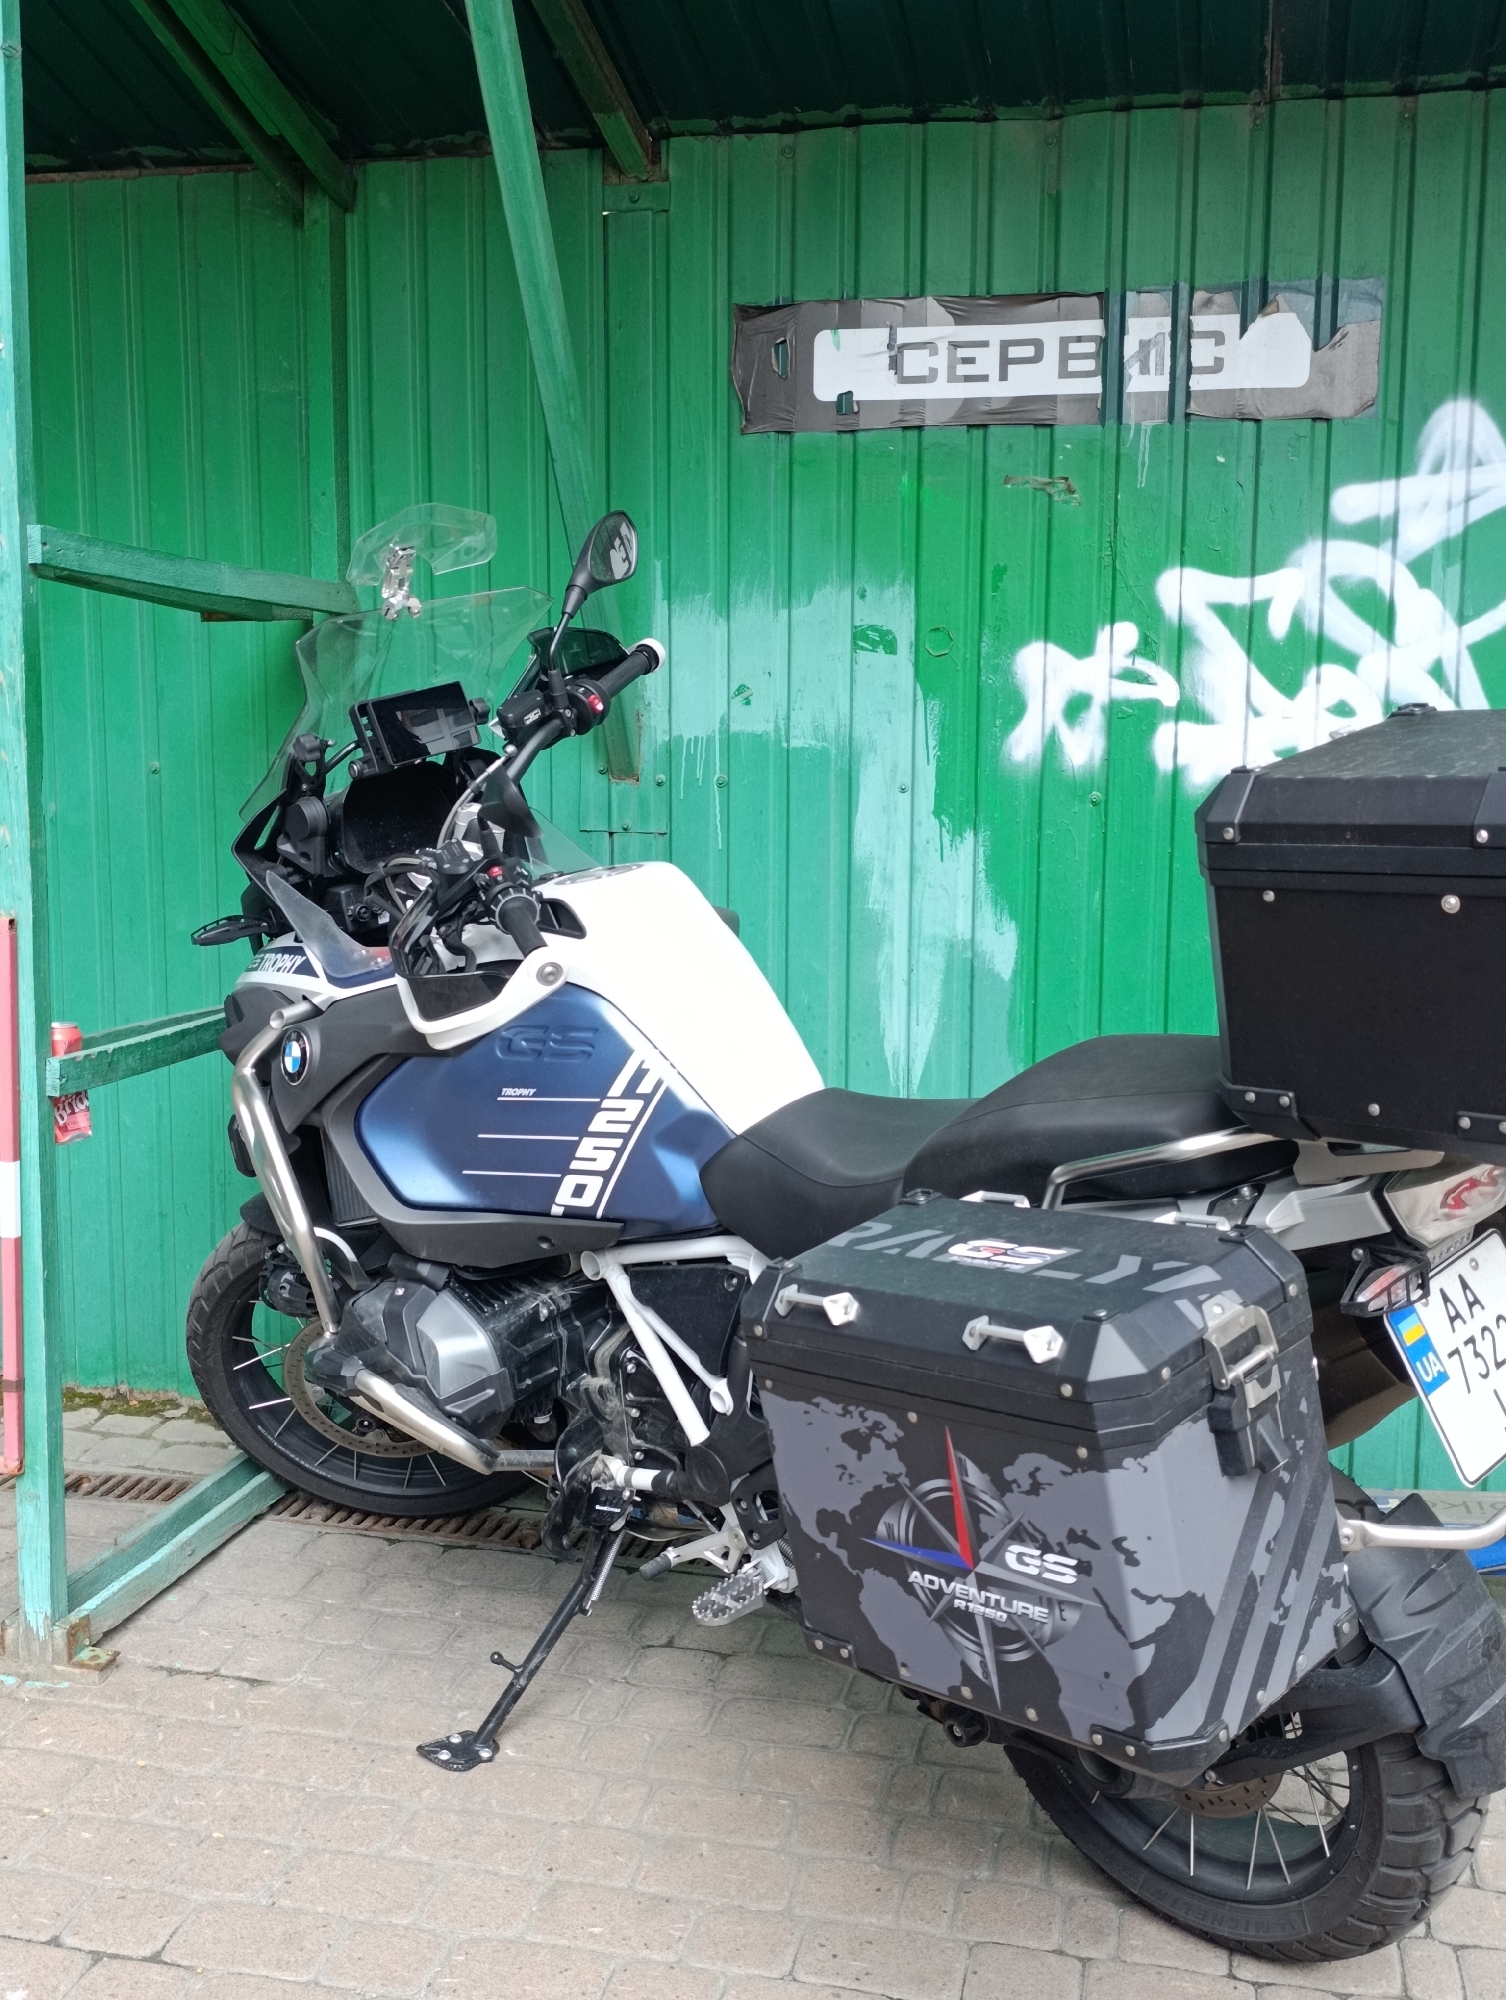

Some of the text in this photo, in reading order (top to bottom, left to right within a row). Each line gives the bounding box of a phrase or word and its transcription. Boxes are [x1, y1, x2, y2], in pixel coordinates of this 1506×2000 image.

[258, 953, 306, 973] TROPHY
[496, 1025, 599, 1062] GS
[501, 1088, 537, 1097] TROPHY
[948, 1239, 1067, 1264] GS
[1439, 1273, 1485, 1333] AA
[1416, 1352, 1444, 1383] UA
[1004, 1544, 1079, 1585] GS
[908, 1570, 1049, 1624] ADVENTURE
[953, 1598, 1008, 1623] R1250
